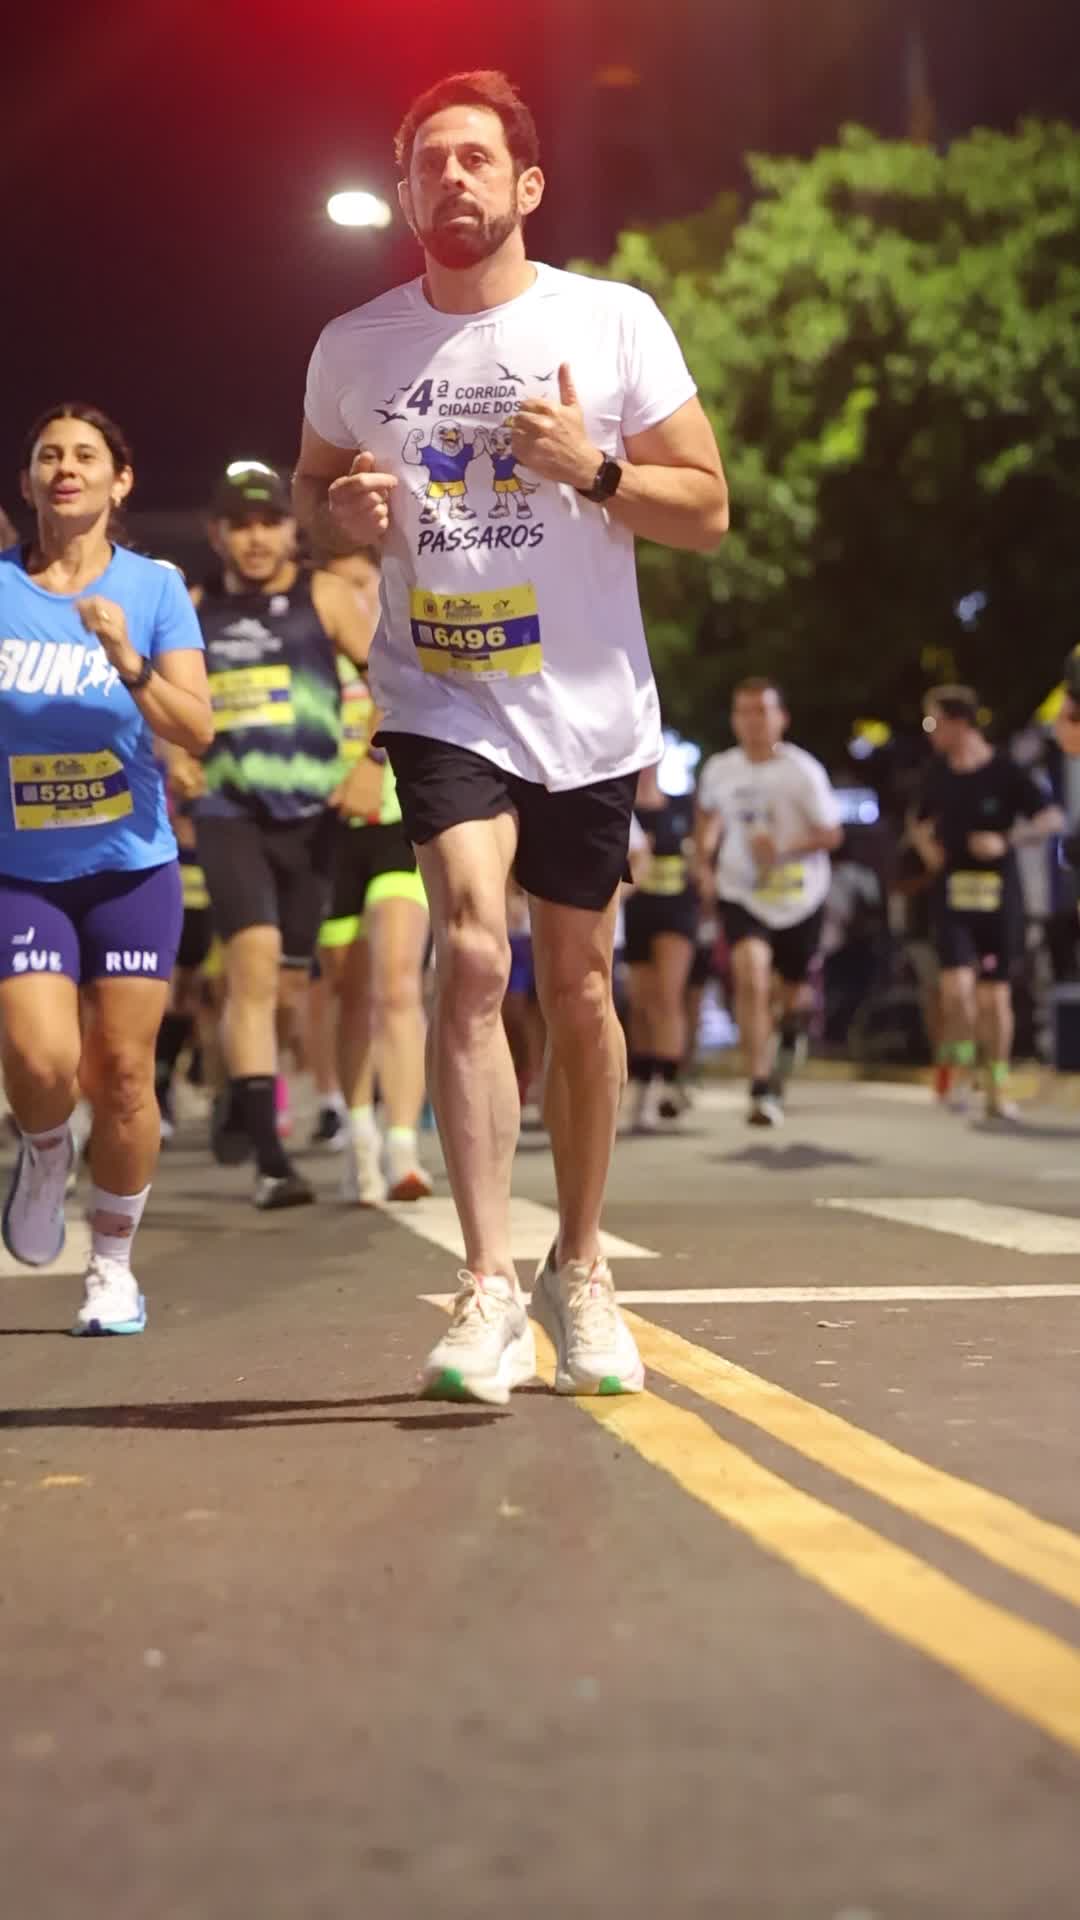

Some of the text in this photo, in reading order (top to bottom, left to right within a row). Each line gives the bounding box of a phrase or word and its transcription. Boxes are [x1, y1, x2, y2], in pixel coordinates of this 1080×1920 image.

[407, 378, 517, 416] 4ª CORRIDA
[438, 400, 521, 416] CIDADE DOS
[417, 522, 544, 555] PÁSSAROS
[434, 626, 506, 649] 6496
[0, 639, 86, 696] RUN
[40, 782, 106, 801] 5286
[105, 950, 158, 972] RUN
